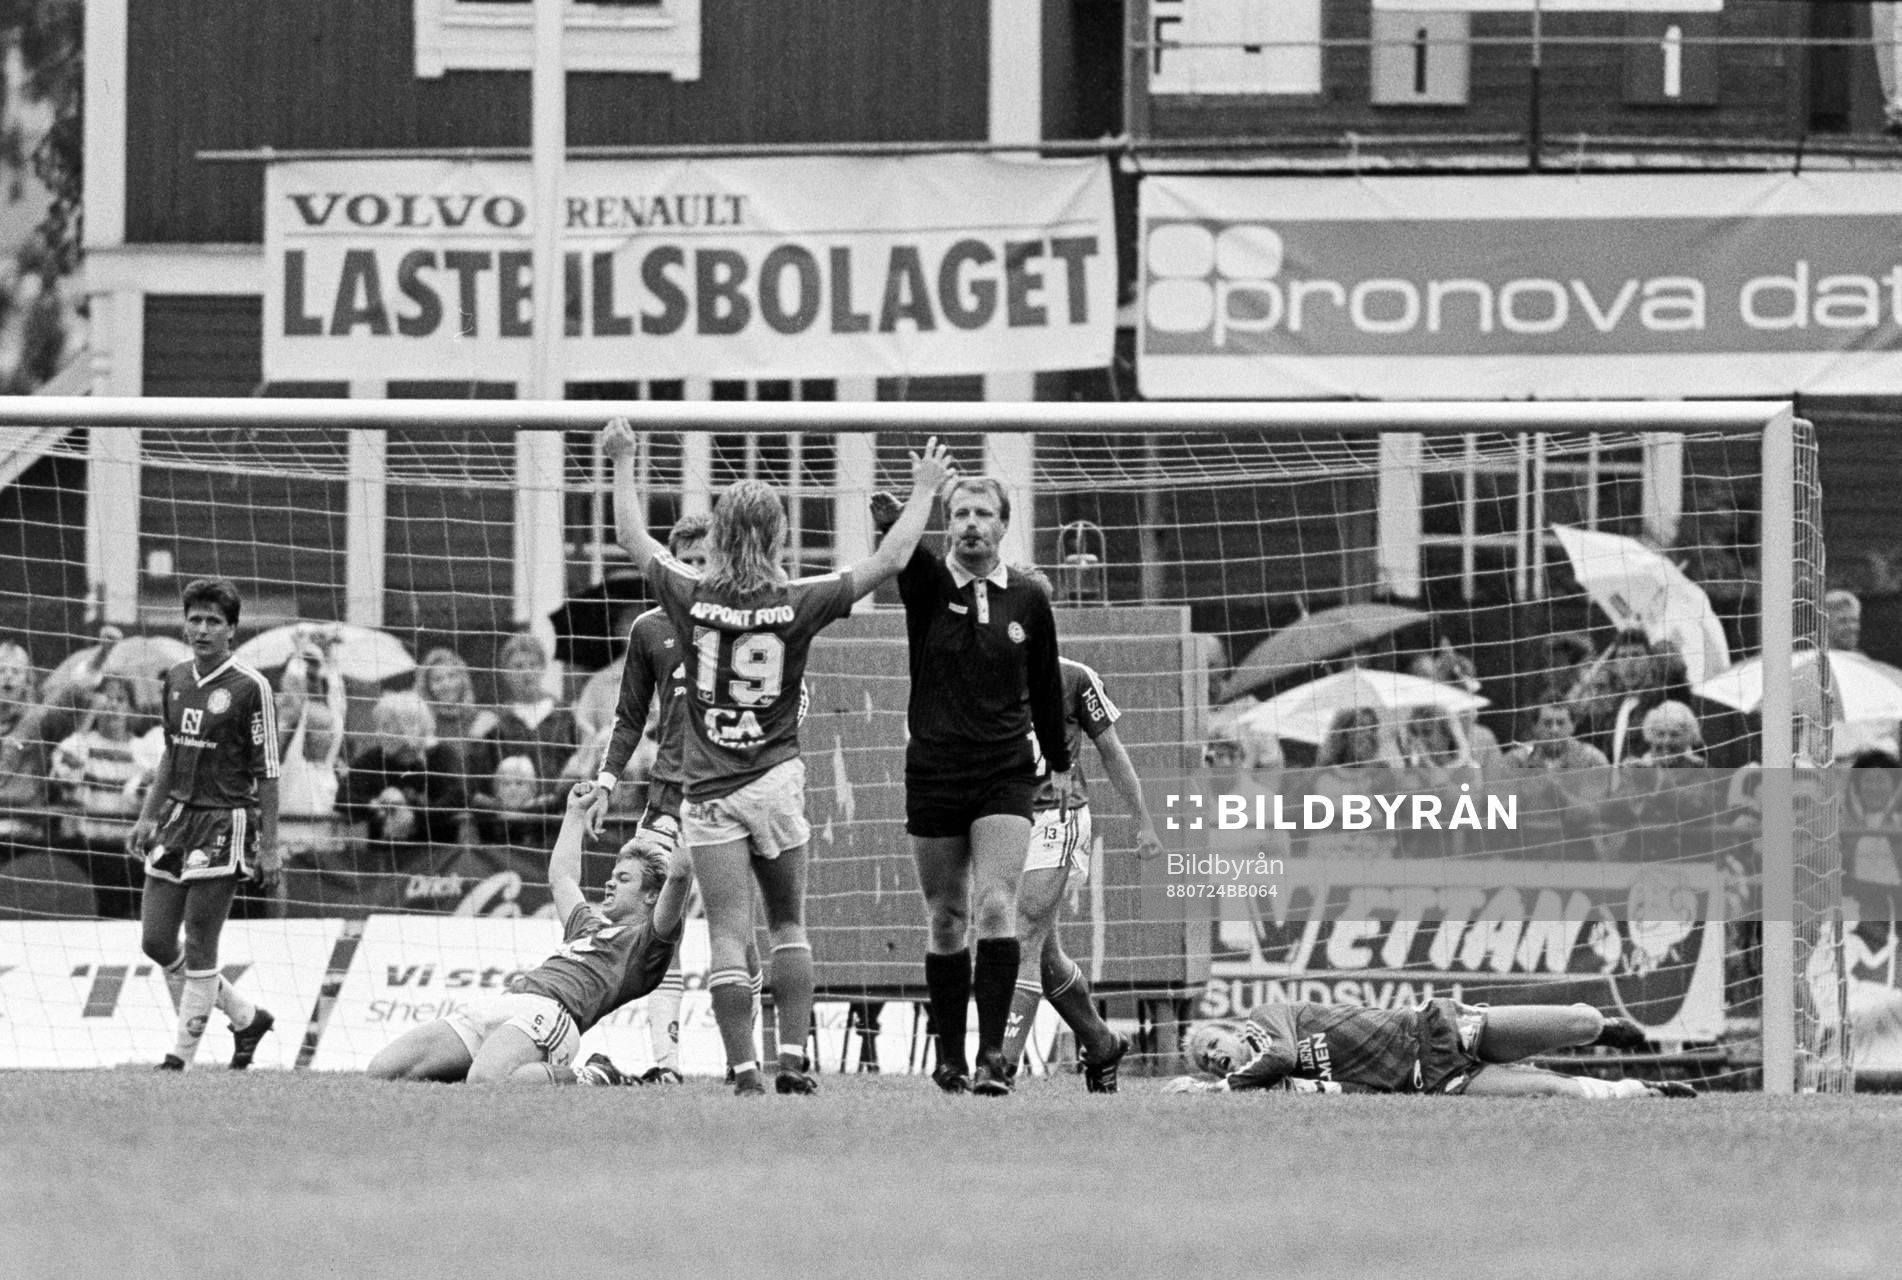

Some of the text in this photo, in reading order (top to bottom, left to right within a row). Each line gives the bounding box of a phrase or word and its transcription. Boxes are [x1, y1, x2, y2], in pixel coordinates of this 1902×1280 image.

[286, 193, 752, 229] VOLVO RENAULT
[283, 236, 1100, 338] LASTBILSBOLAGET
[1214, 277, 1706, 347] pronova
[755, 605, 795, 626] FOTO
[692, 625, 786, 708] 19
[1081, 687, 1106, 722] HSB
[1043, 826, 1057, 840] 13
[386, 962, 437, 987] Vi
[534, 1014, 545, 1026] 6
